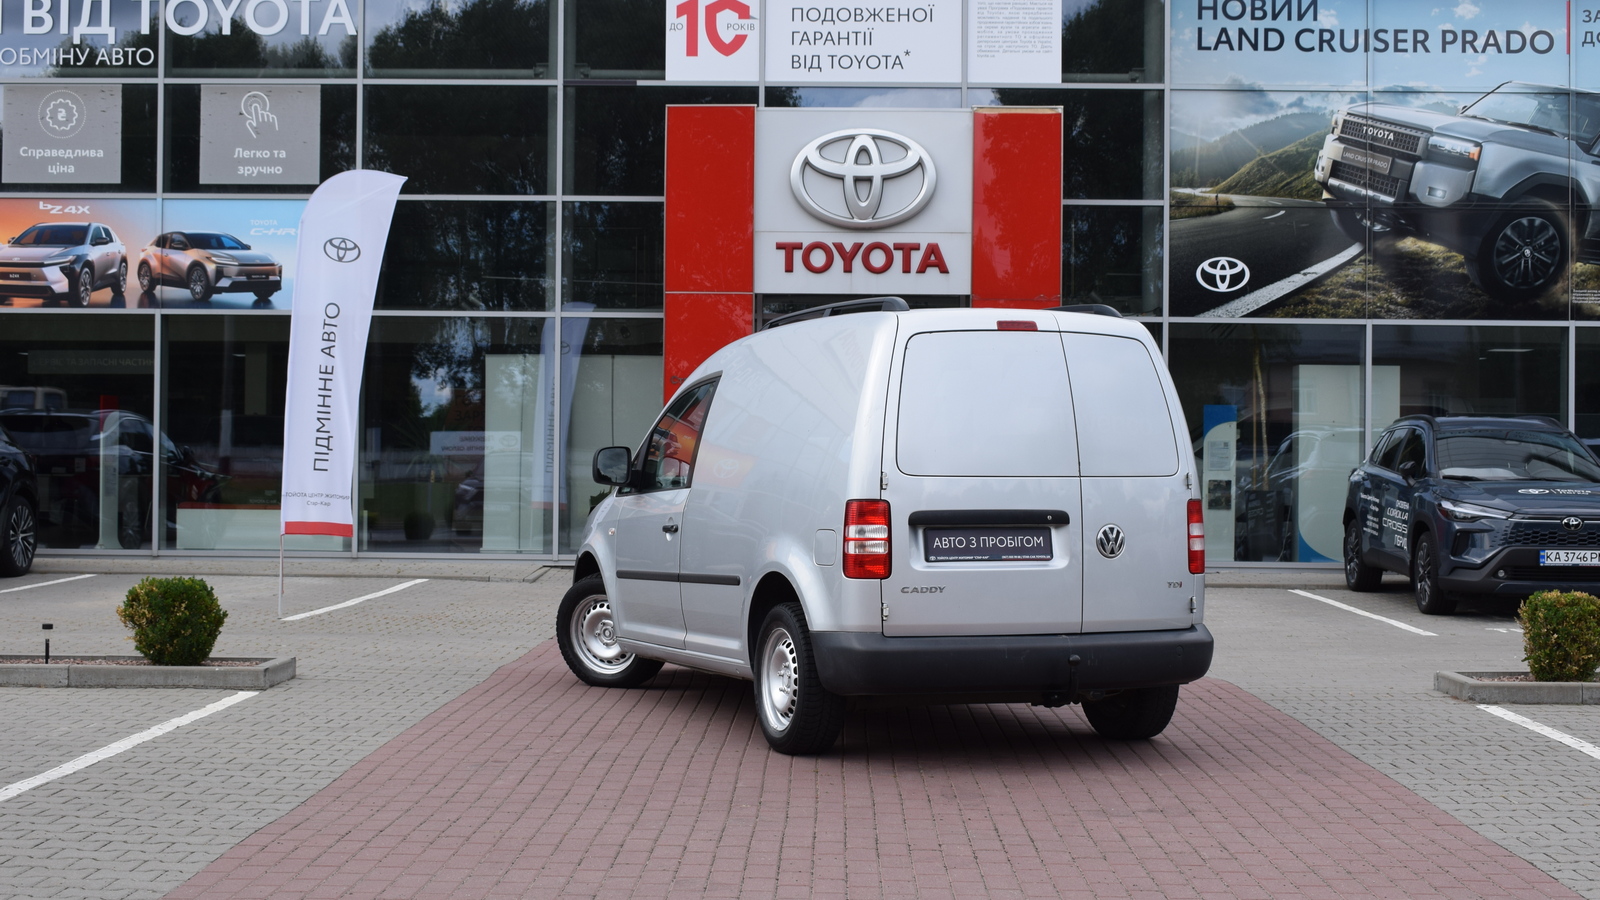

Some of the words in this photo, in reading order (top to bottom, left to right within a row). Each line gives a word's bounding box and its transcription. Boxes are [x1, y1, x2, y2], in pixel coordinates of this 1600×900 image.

[791, 4, 935, 25] ПОДОВЖЕНОЇ
[23, 0, 116, 45] ВІД
[131, 0, 358, 36] TOYOTA
[669, 22, 684, 31] ДО
[726, 23, 755, 31] РОКІВ
[791, 27, 874, 46] ГАРАНТІЇ
[1197, 27, 1285, 51] LAND
[1294, 28, 1430, 53] CRUISER
[1441, 29, 1555, 54] PRADO
[0, 47, 89, 66] ОБМІНУ
[95, 48, 155, 66] АВТО
[791, 55, 822, 72] ВІД
[1362, 126, 1394, 140] TOYOTA
[20, 146, 104, 160] Справедлива
[233, 148, 270, 159] Легко
[272, 150, 286, 159] та
[48, 163, 75, 176] ціна
[237, 165, 283, 176] зручно
[250, 228, 299, 236] C-HR
[776, 241, 949, 274] TOYOTA
[320, 302, 341, 358] АВТО
[313, 364, 335, 472] ПІДМІННЕ
[1382, 517, 1408, 534] CROSS
[933, 537, 966, 549] АВТО
[969, 537, 977, 548] З
[980, 536, 1044, 548] ПРОБІГОМ
[1546, 552, 1561, 562] KA
[1564, 552, 1588, 562] 3746
[1590, 552, 1600, 562] P
[901, 586, 946, 594] CADDY
